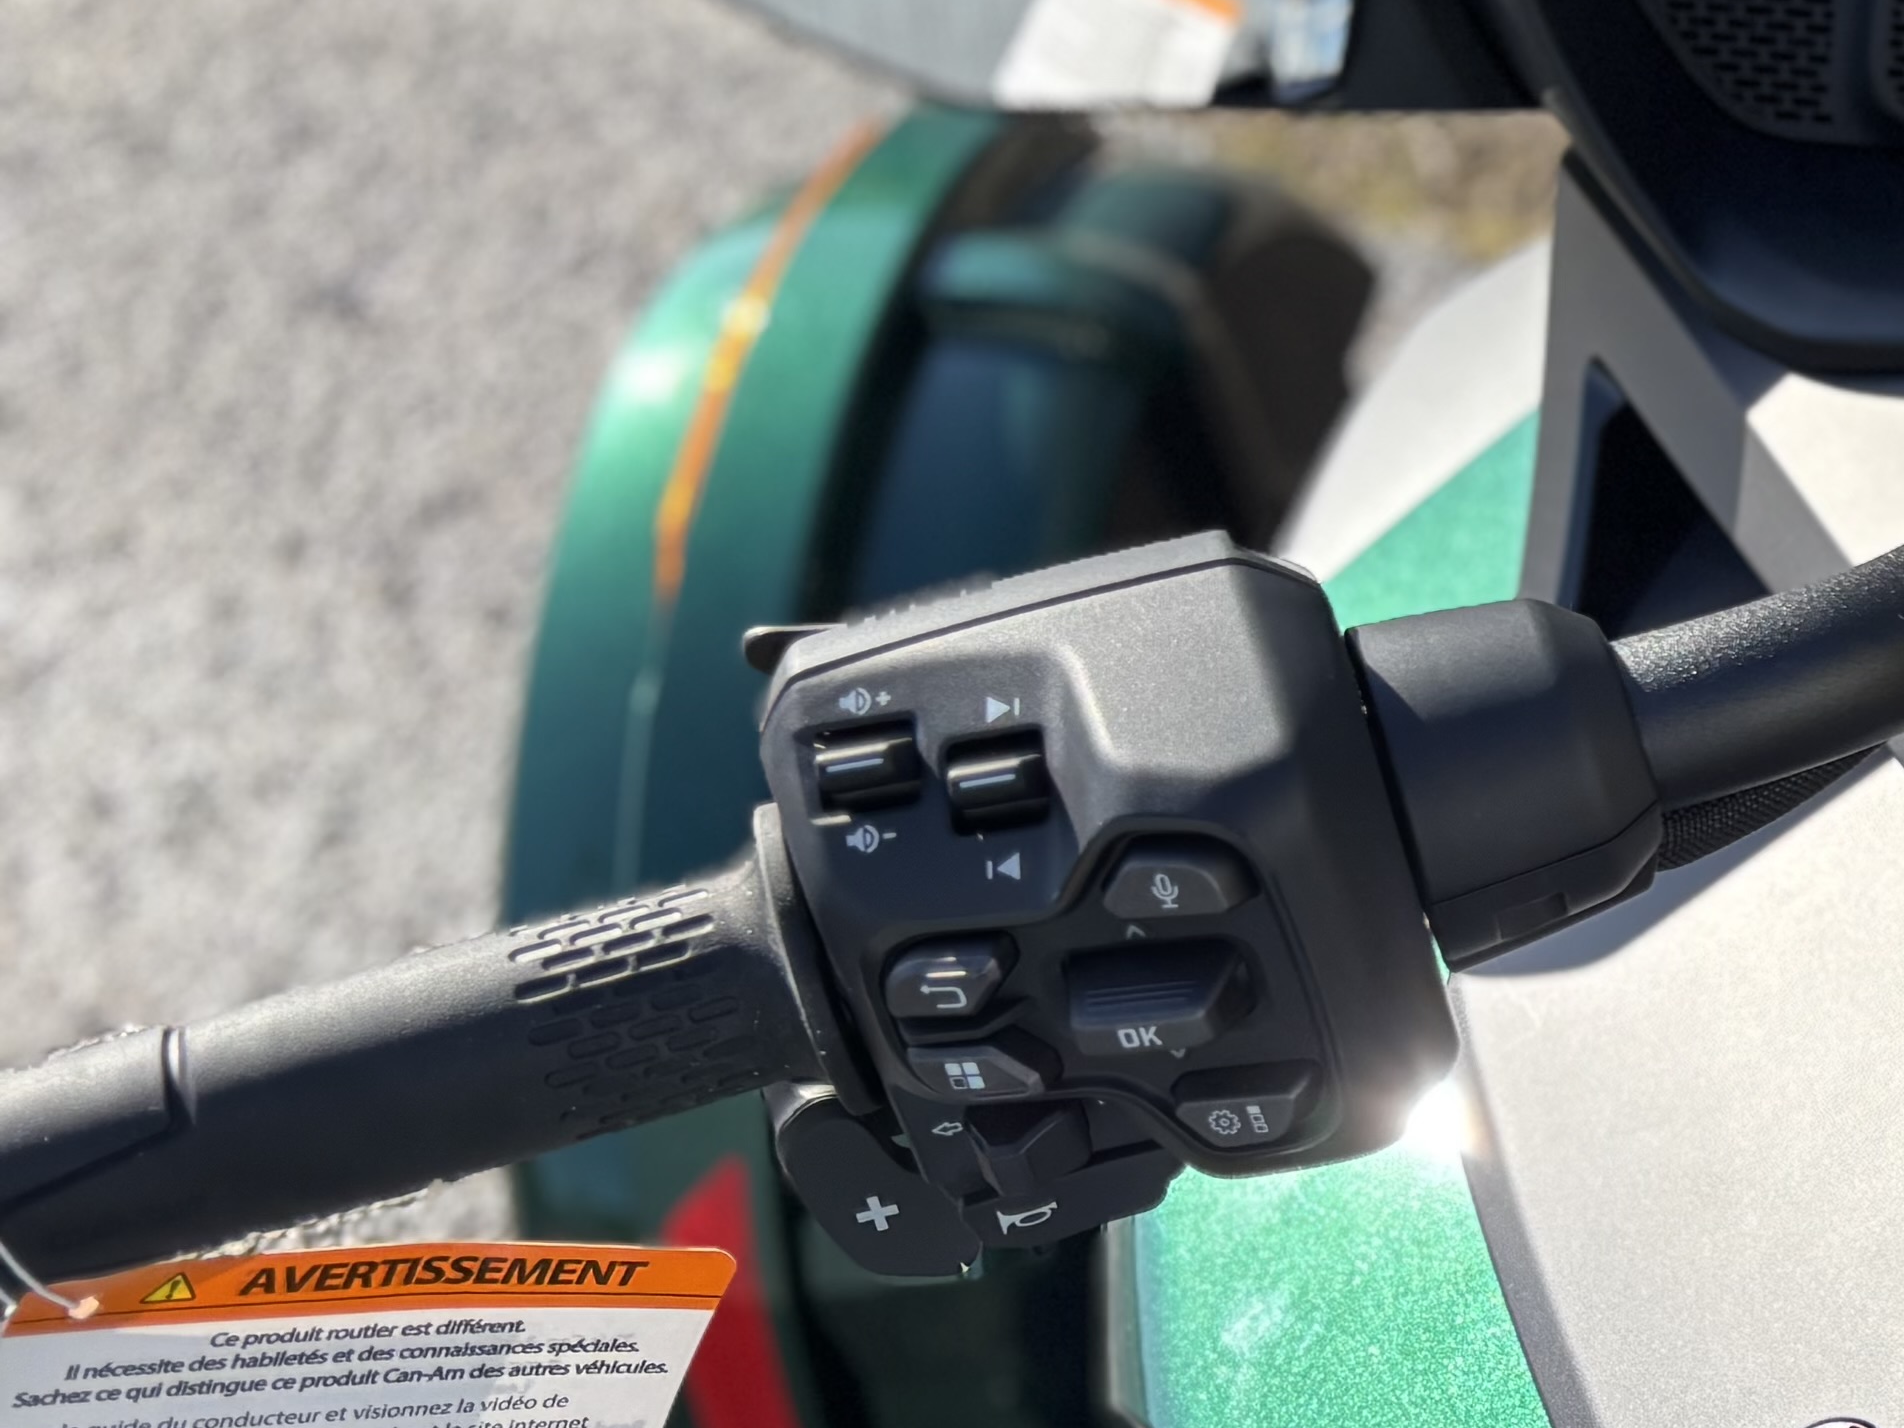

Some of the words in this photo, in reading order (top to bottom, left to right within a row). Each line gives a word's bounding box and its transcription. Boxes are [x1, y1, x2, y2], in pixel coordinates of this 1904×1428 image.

[1117, 1025, 1163, 1049] OK
[238, 1255, 651, 1298] AVERTISSEMENT
[353, 1402, 454, 1420] visionnez
[480, 1395, 538, 1412] vidéo
